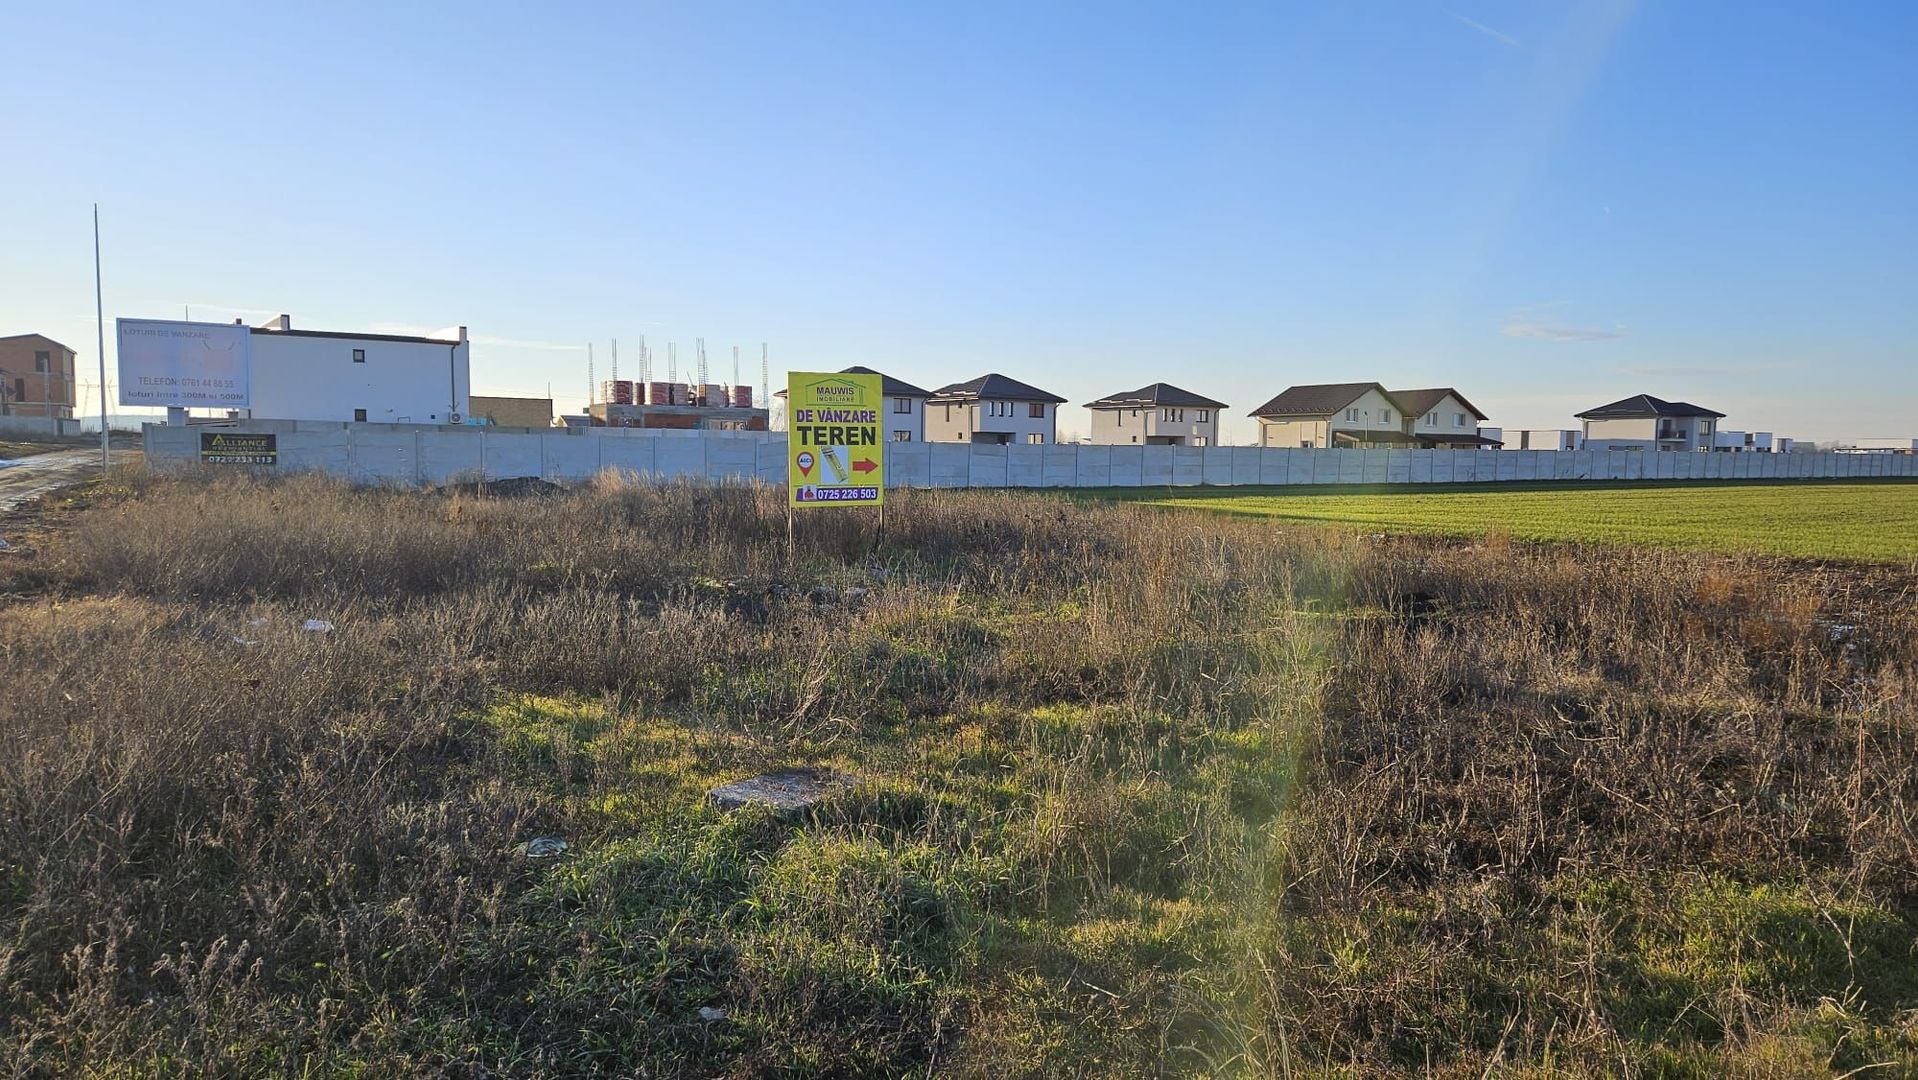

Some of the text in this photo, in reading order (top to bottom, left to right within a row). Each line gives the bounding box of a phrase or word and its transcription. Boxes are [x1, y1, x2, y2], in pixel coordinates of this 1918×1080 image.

[816, 386, 855, 395] MAUWIS
[796, 407, 876, 423] DE VÂNZARE
[211, 433, 268, 447] ALLIANCE
[796, 426, 876, 446] TEREN
[817, 488, 877, 499] 0725 226 503
